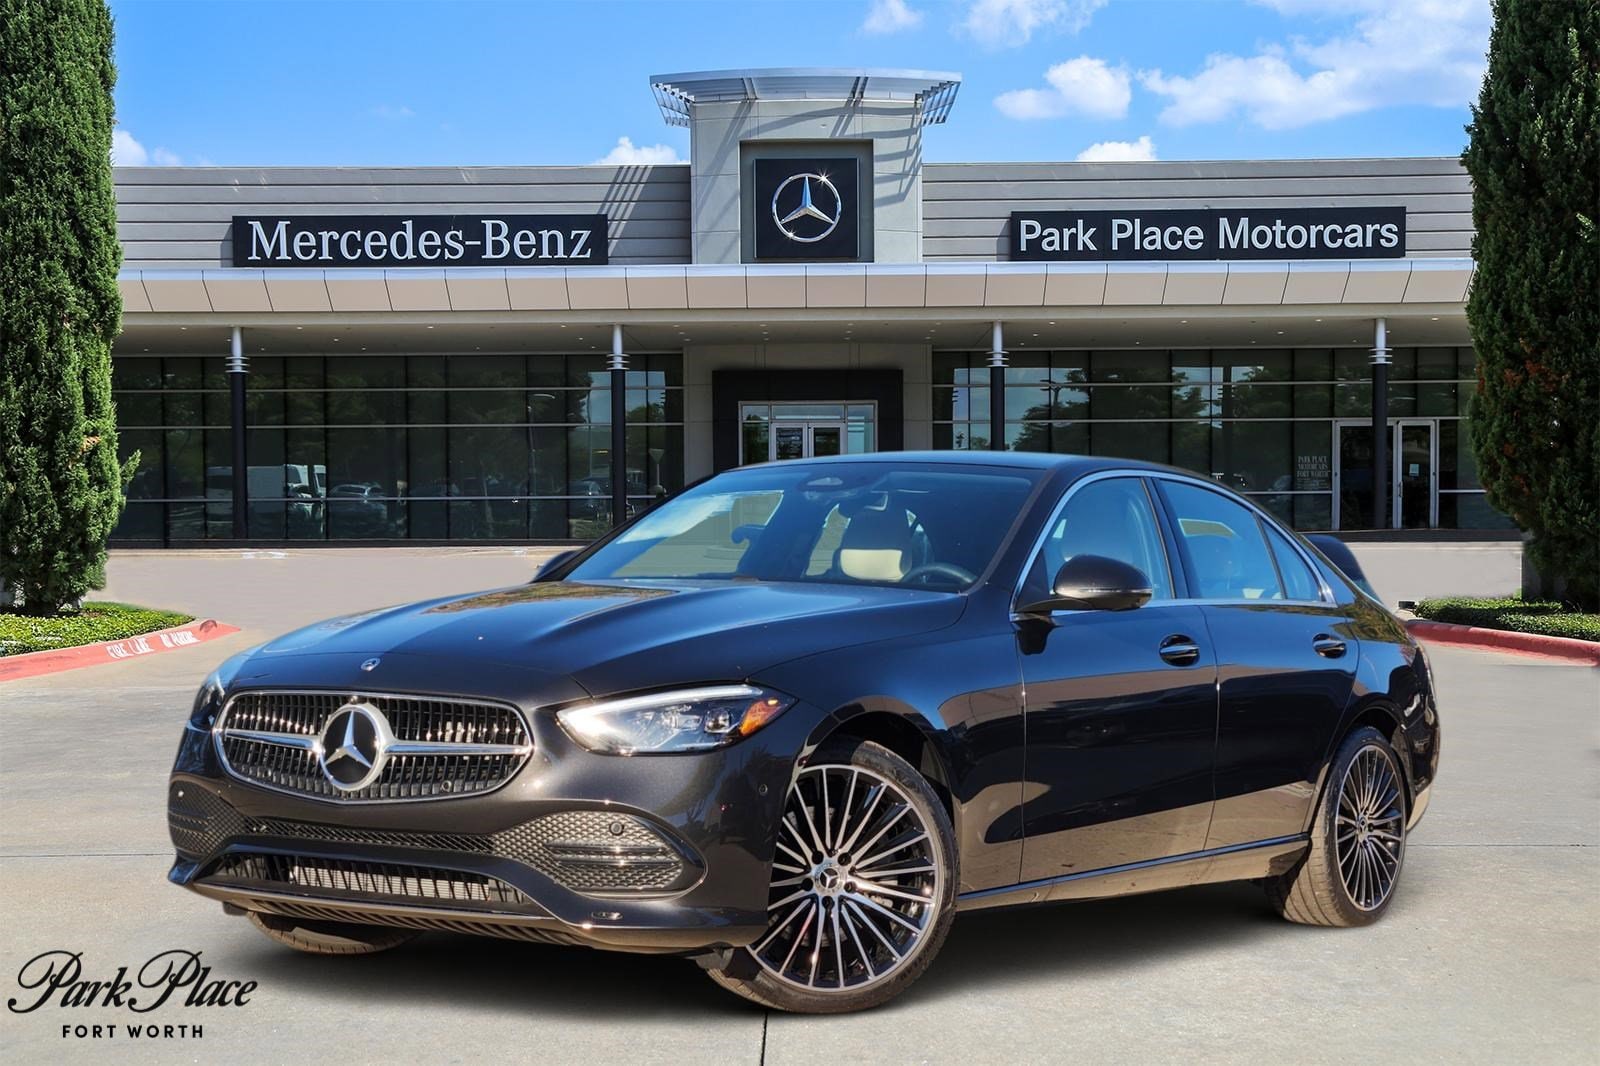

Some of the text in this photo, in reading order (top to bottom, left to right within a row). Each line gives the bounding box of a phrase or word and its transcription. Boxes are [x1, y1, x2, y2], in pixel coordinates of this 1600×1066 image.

[248, 219, 592, 260] Mercedes-Benz
[1020, 216, 1399, 252] Park Place Motorcars
